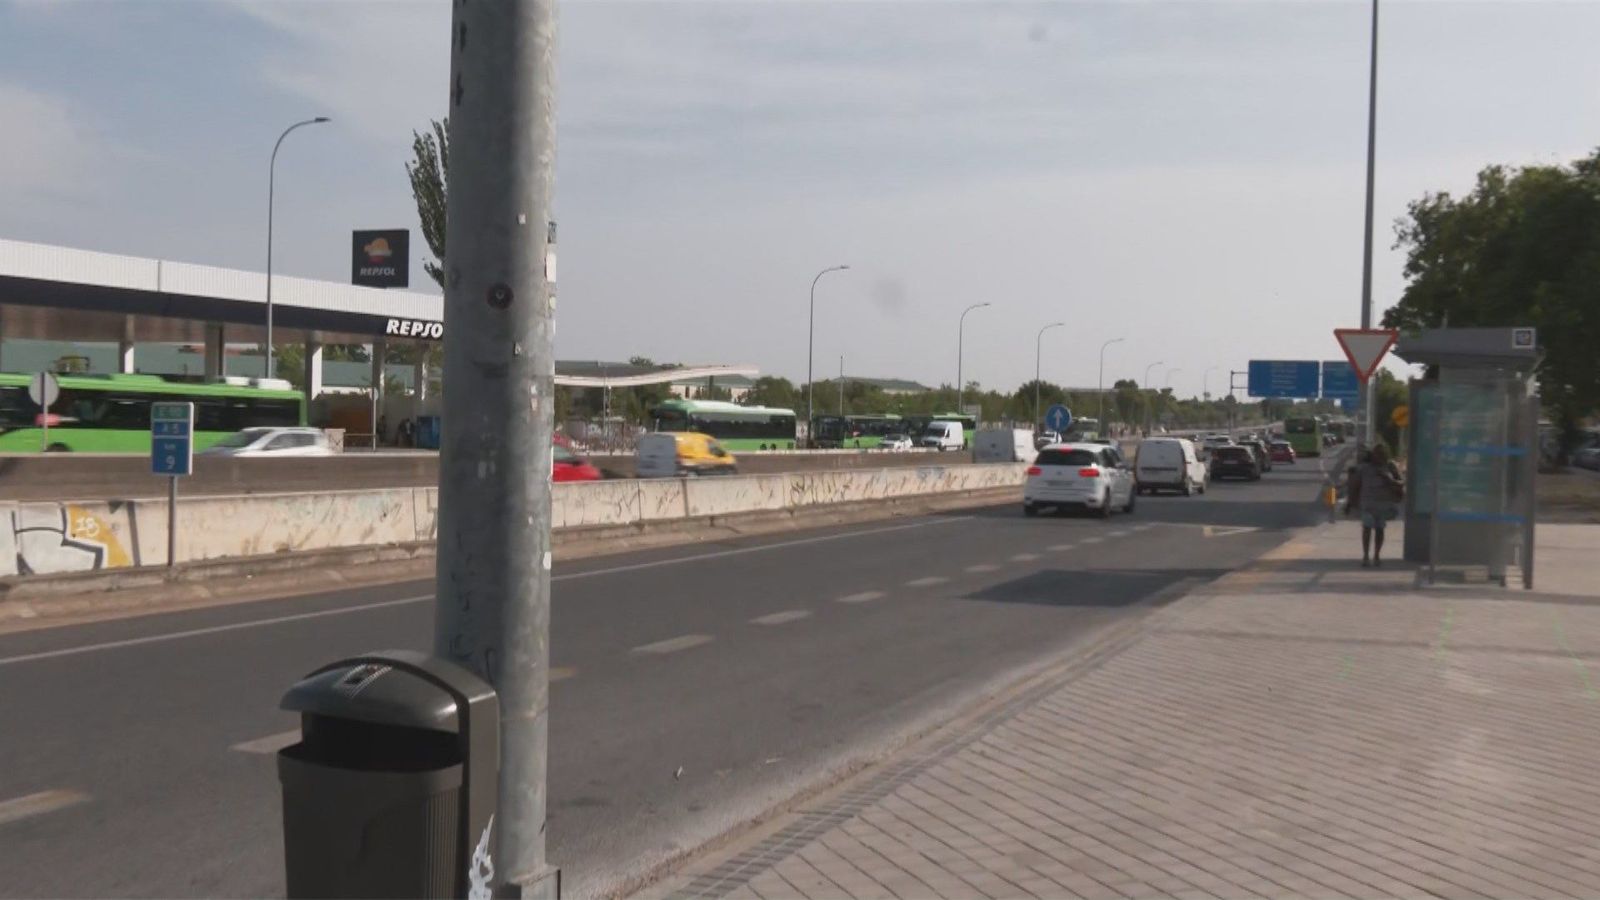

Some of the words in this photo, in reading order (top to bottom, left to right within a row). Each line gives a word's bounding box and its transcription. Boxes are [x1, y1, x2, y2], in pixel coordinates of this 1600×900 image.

[360, 267, 396, 276] REPSOL
[386, 319, 443, 338] REPSO
[165, 455, 175, 470] 9
